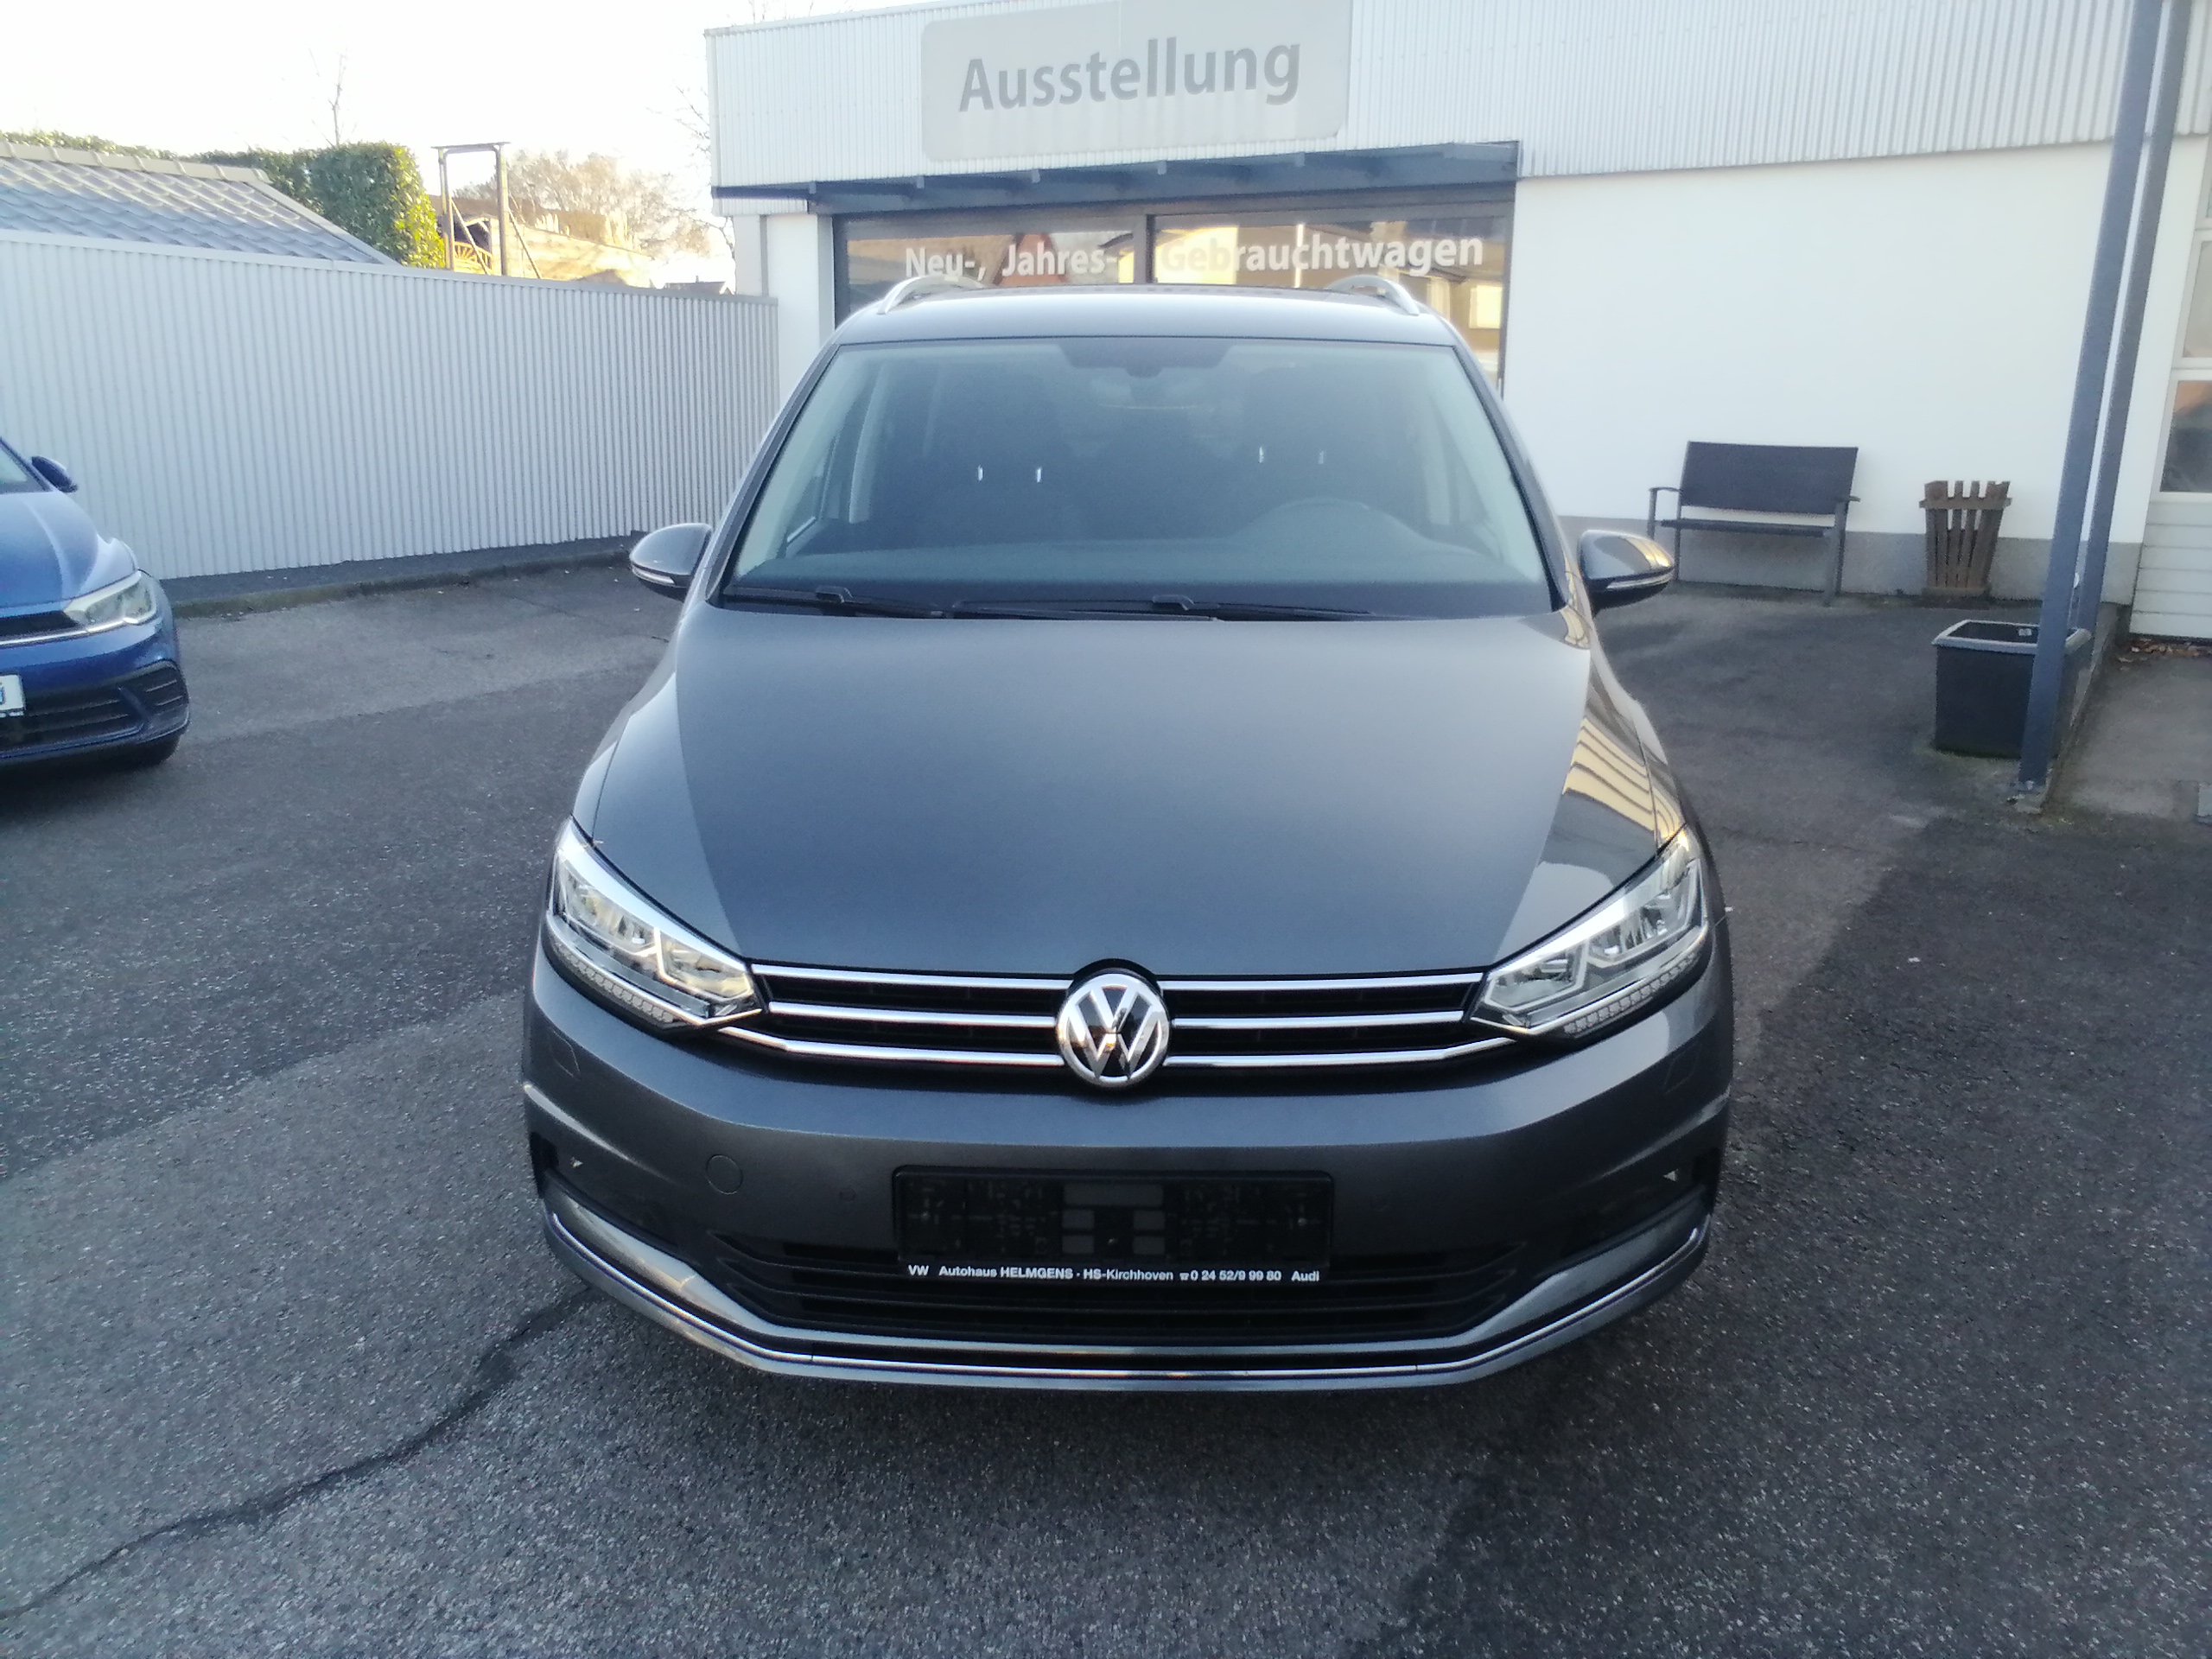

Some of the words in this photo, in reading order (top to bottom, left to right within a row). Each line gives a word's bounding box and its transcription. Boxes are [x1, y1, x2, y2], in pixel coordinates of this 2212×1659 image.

[958, 36, 1301, 112] Ausstellung
[906, 247, 986, 282] Neu-,
[1002, 241, 1118, 277] Jahres-
[1160, 233, 1484, 276] Gebrauchtwagen
[907, 1264, 930, 1276] VW
[938, 1265, 997, 1277] Autohaus
[1000, 1266, 1073, 1280] HELMGENS
[1083, 1267, 1173, 1281] HS-Kirchhoven
[1201, 1270, 1216, 1281] 24
[1291, 1269, 1320, 1282] Audi
